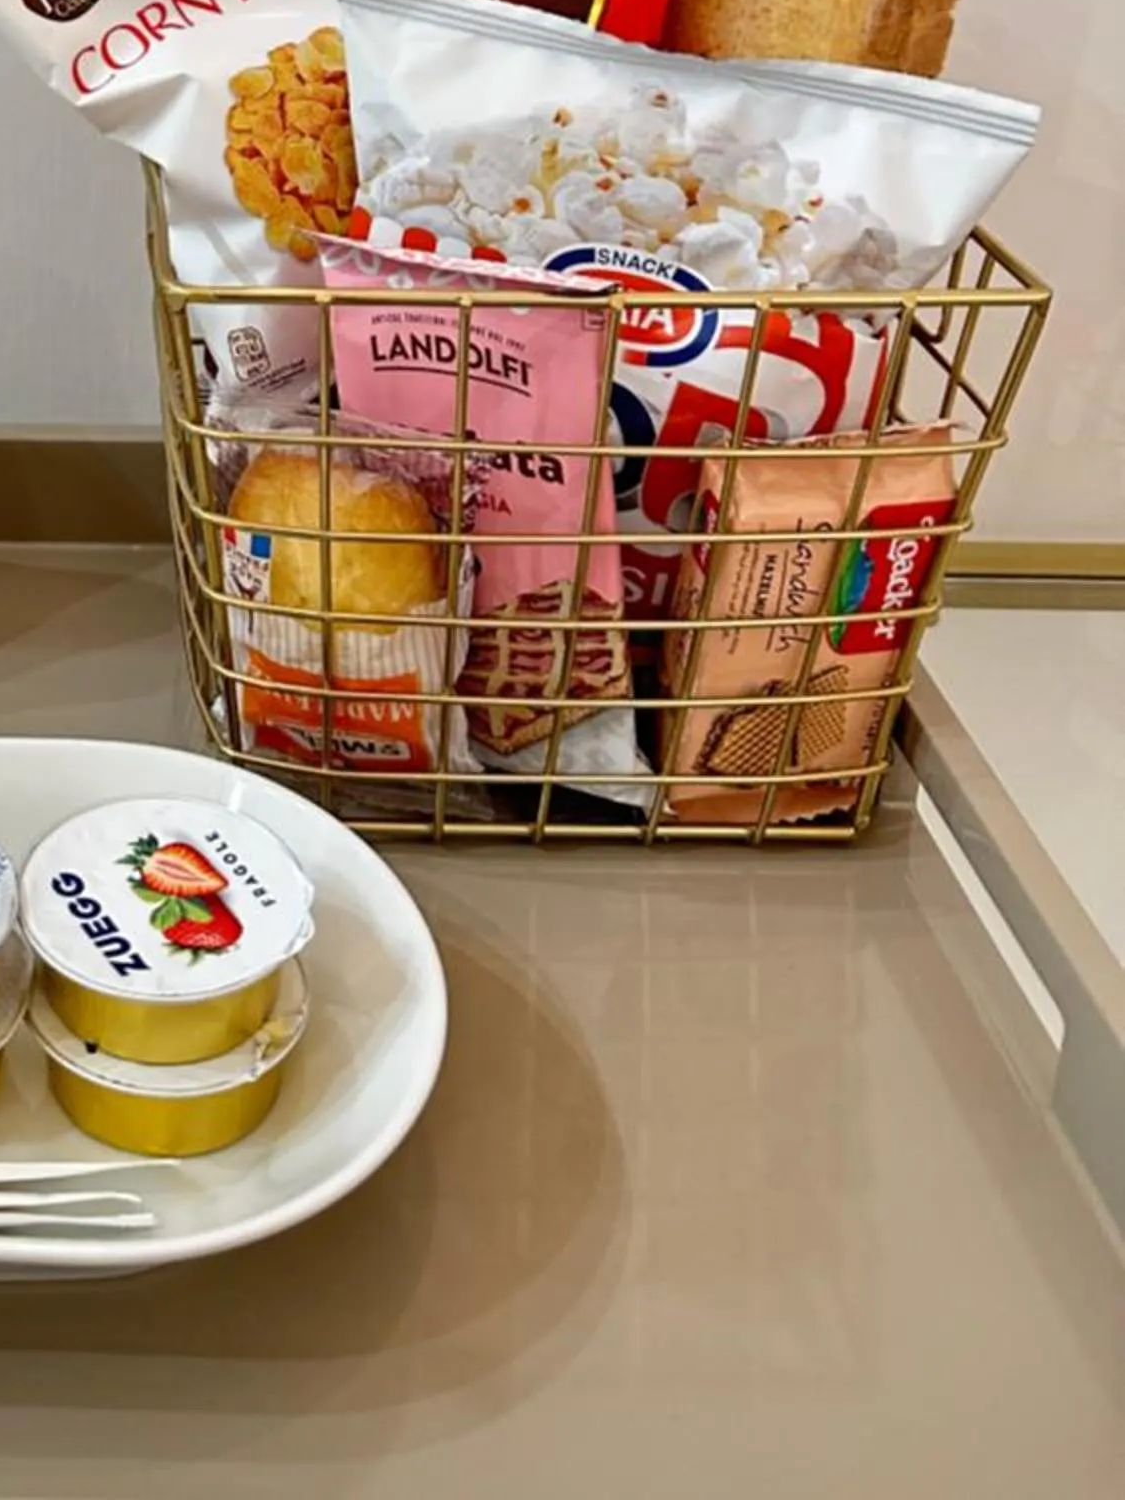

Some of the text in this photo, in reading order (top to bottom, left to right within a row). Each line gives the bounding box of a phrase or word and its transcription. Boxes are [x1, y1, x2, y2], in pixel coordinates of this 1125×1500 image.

[596, 247, 674, 278] SNACK
[369, 333, 535, 388] LANDOLFI
[751, 553, 778, 619] HAZELNU
[775, 516, 834, 655] andwch
[204, 830, 278, 908] FRAGOLE
[50, 871, 152, 978] ZUEGG
